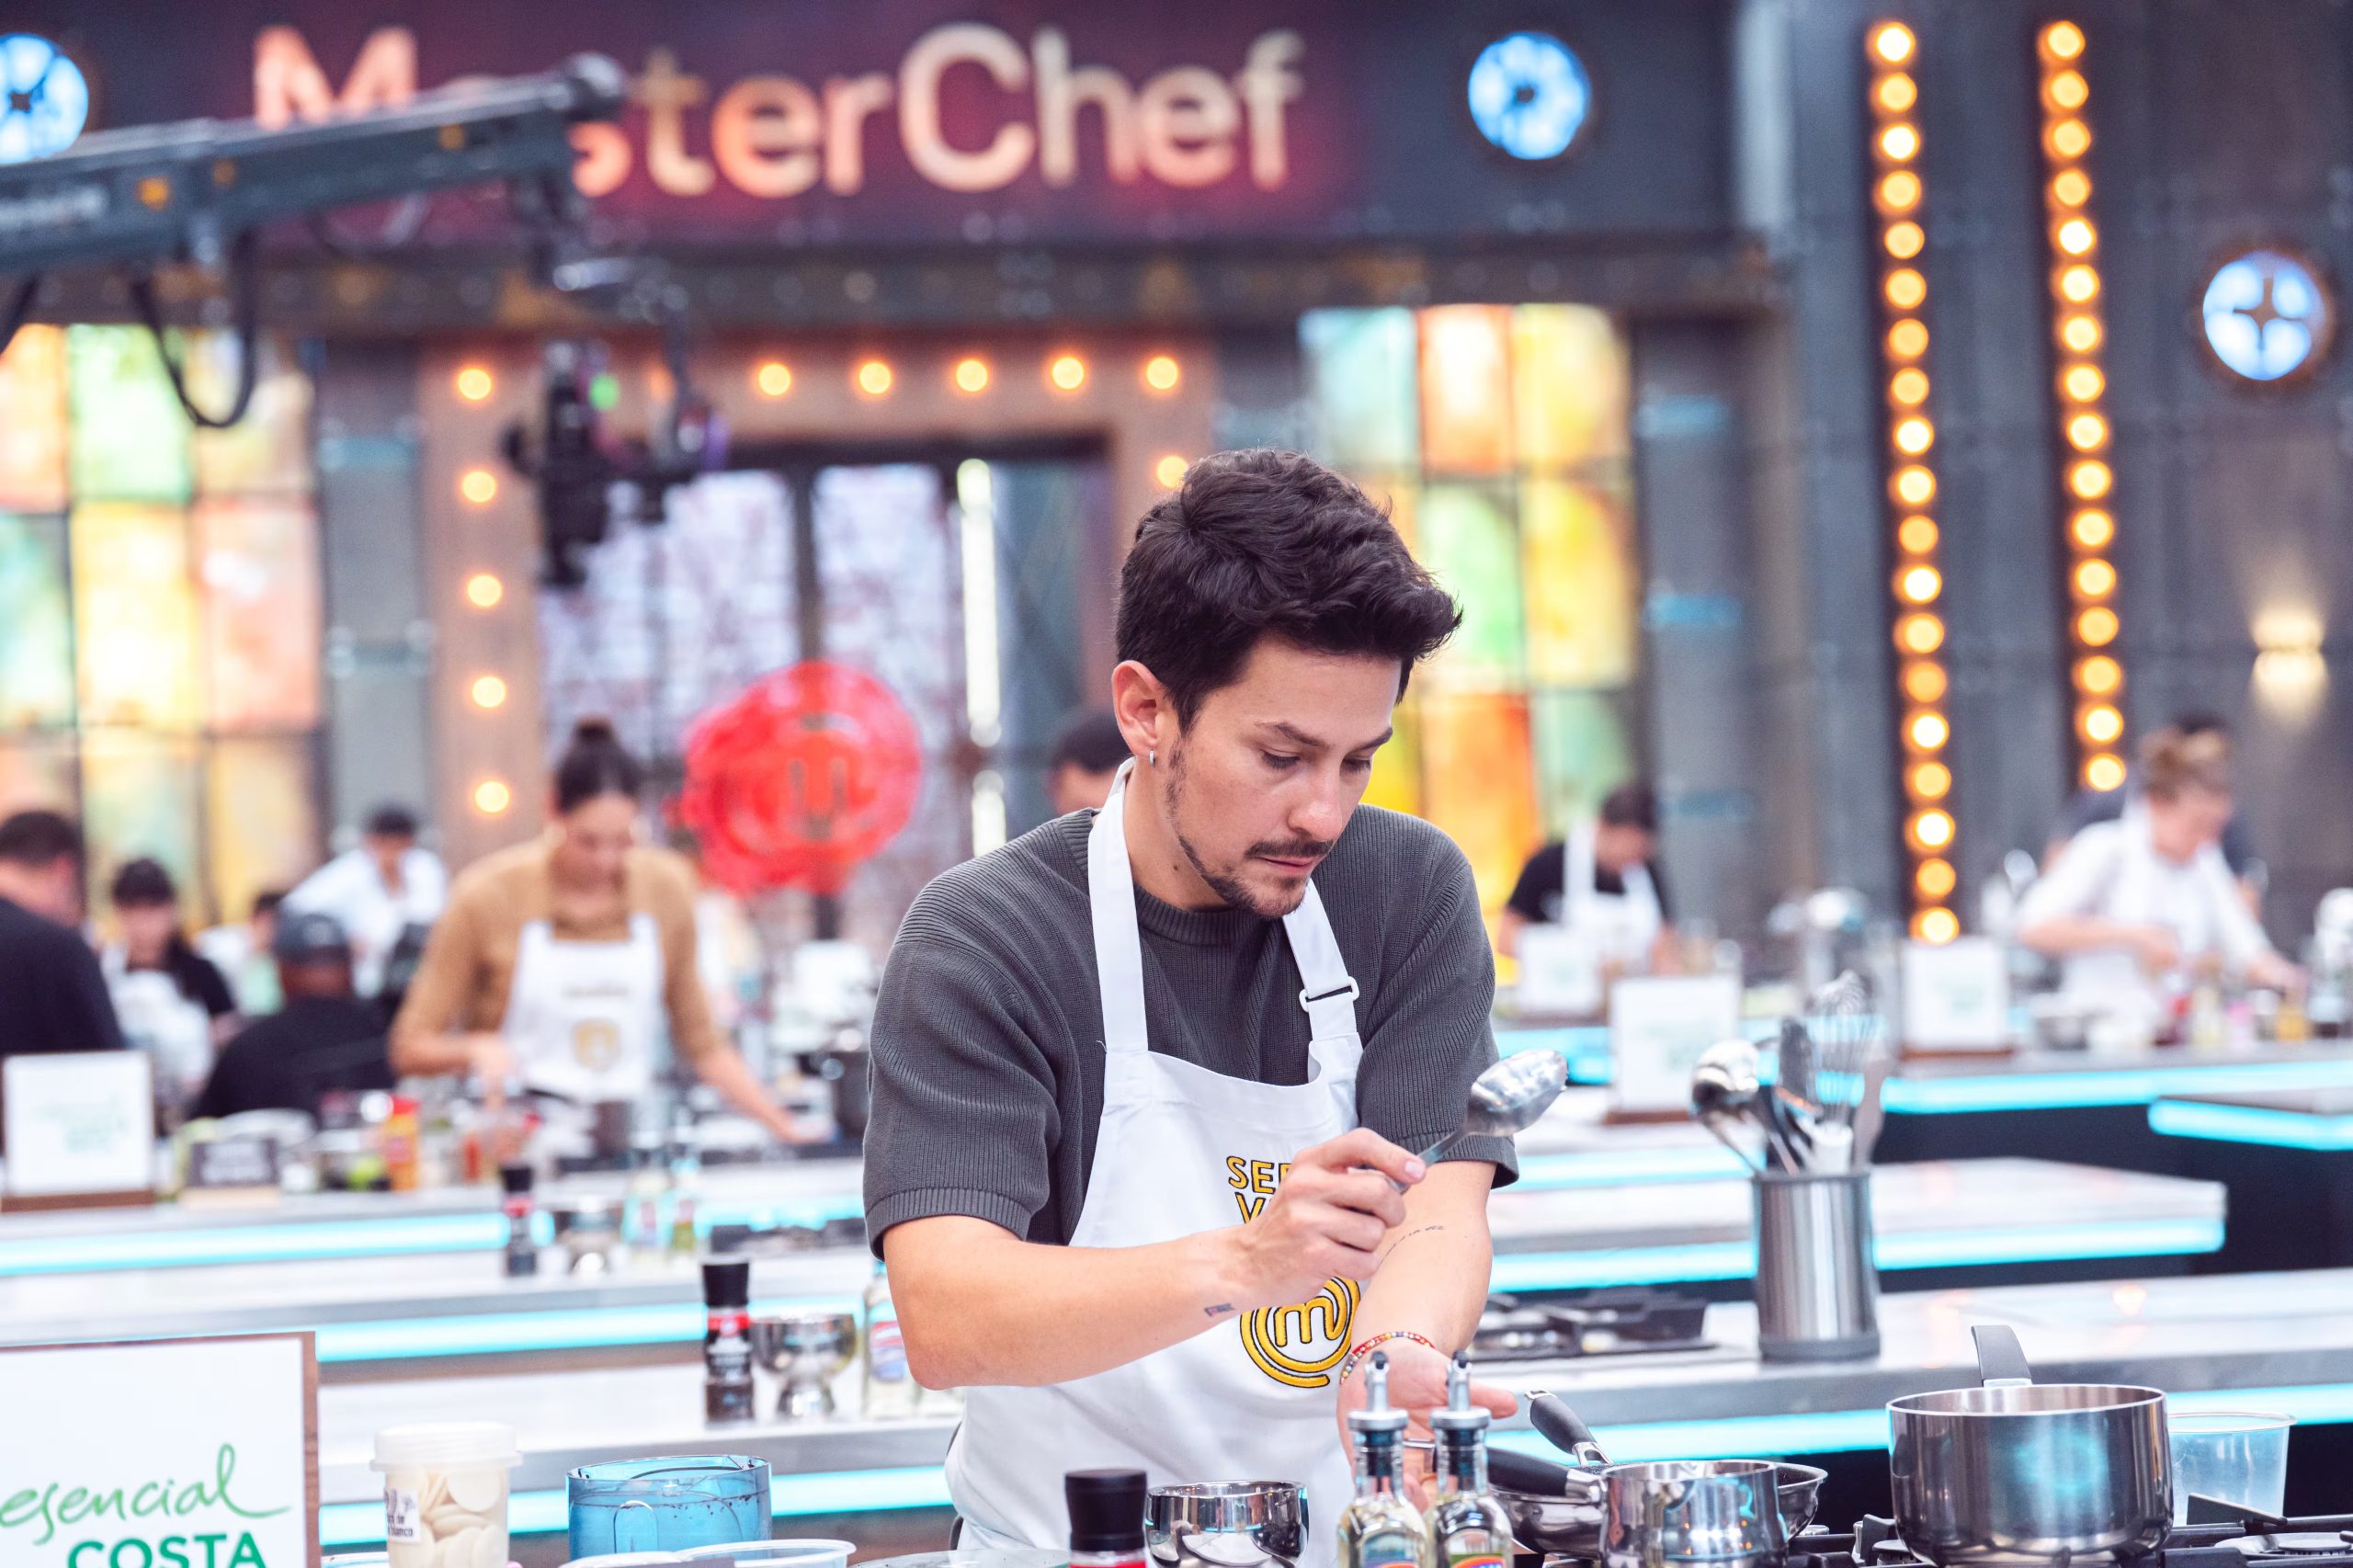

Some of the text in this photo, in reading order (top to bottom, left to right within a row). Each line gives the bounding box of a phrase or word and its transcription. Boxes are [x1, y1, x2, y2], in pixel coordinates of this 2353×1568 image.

[254, 22, 1305, 197] MsterChef
[1234, 1192, 1271, 1224] V
[0, 1442, 292, 1546] esencial
[66, 1531, 267, 1568] COSTA
